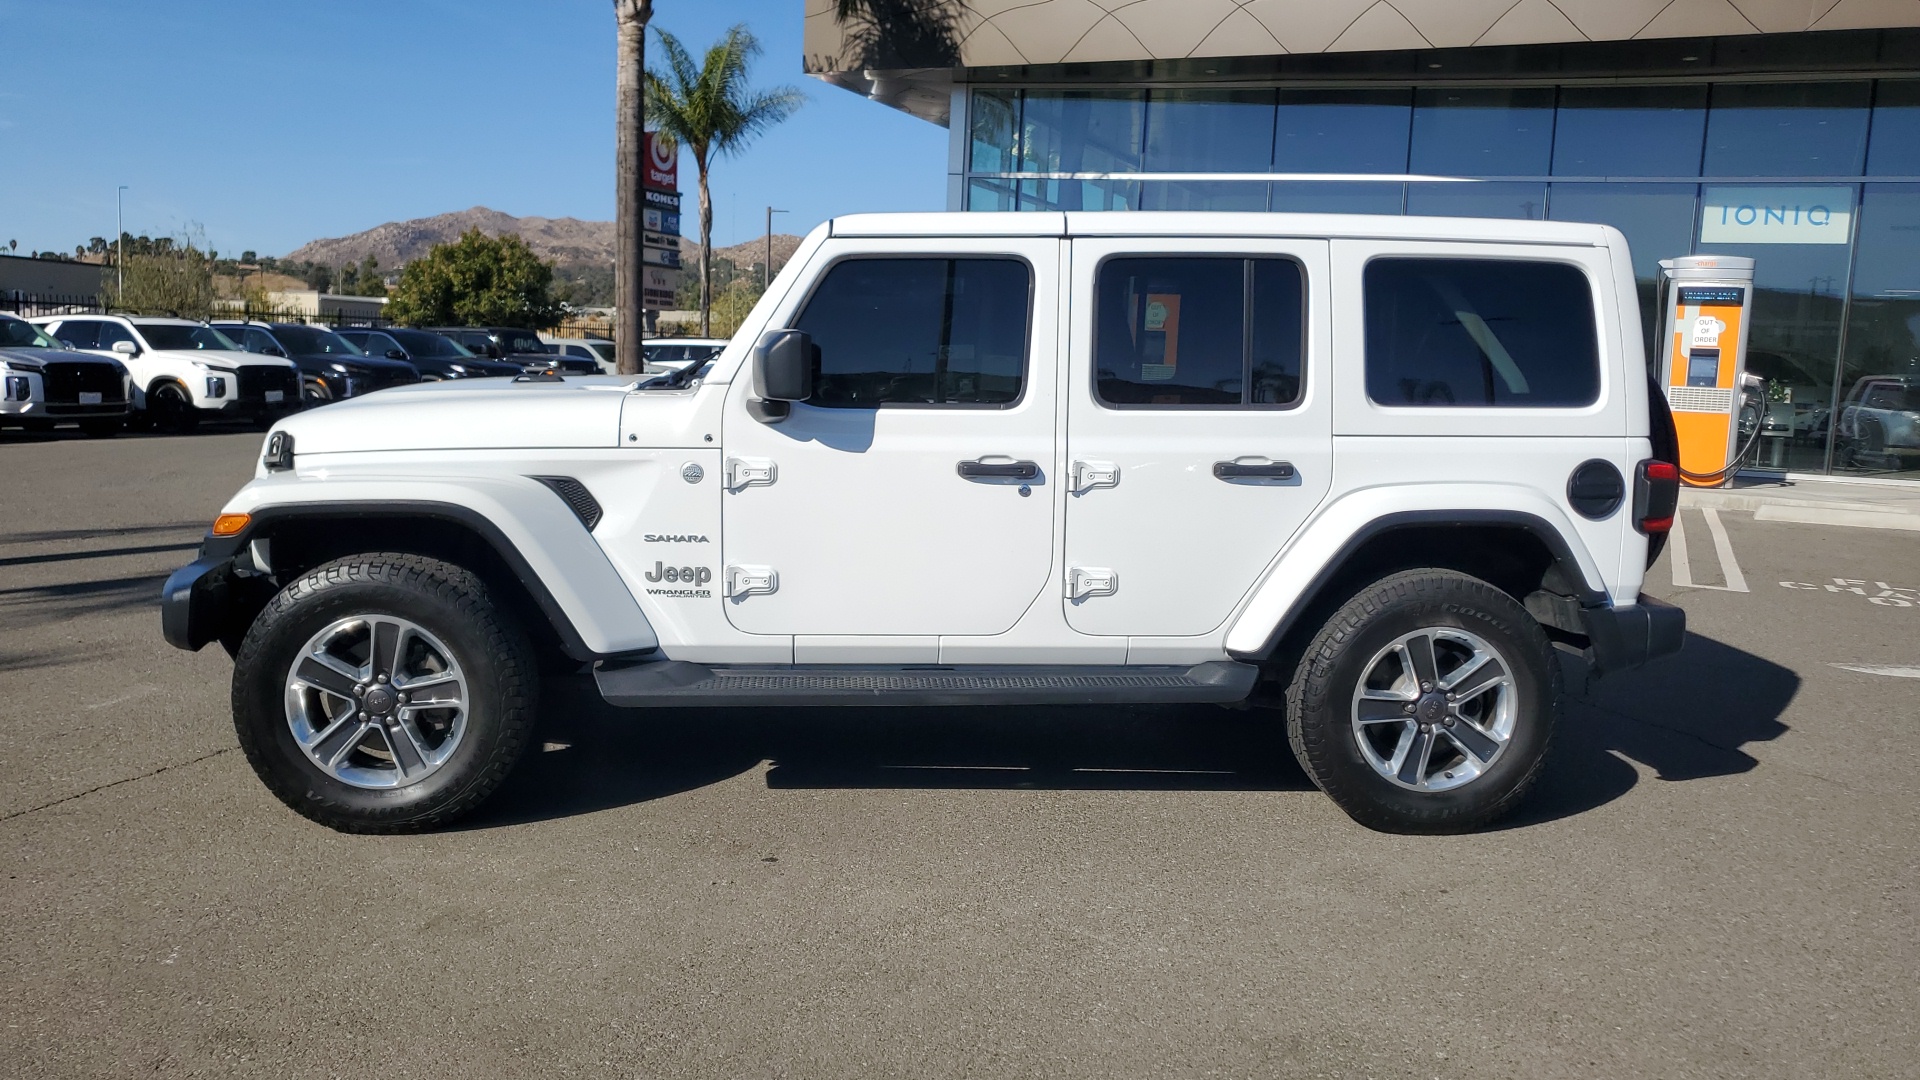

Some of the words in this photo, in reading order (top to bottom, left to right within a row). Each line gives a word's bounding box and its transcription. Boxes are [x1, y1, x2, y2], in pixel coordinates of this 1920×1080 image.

[650, 169, 675, 185] target
[1721, 205, 1830, 226] IONIQ
[643, 534, 710, 543] SAHARA
[644, 561, 712, 587] Jeep
